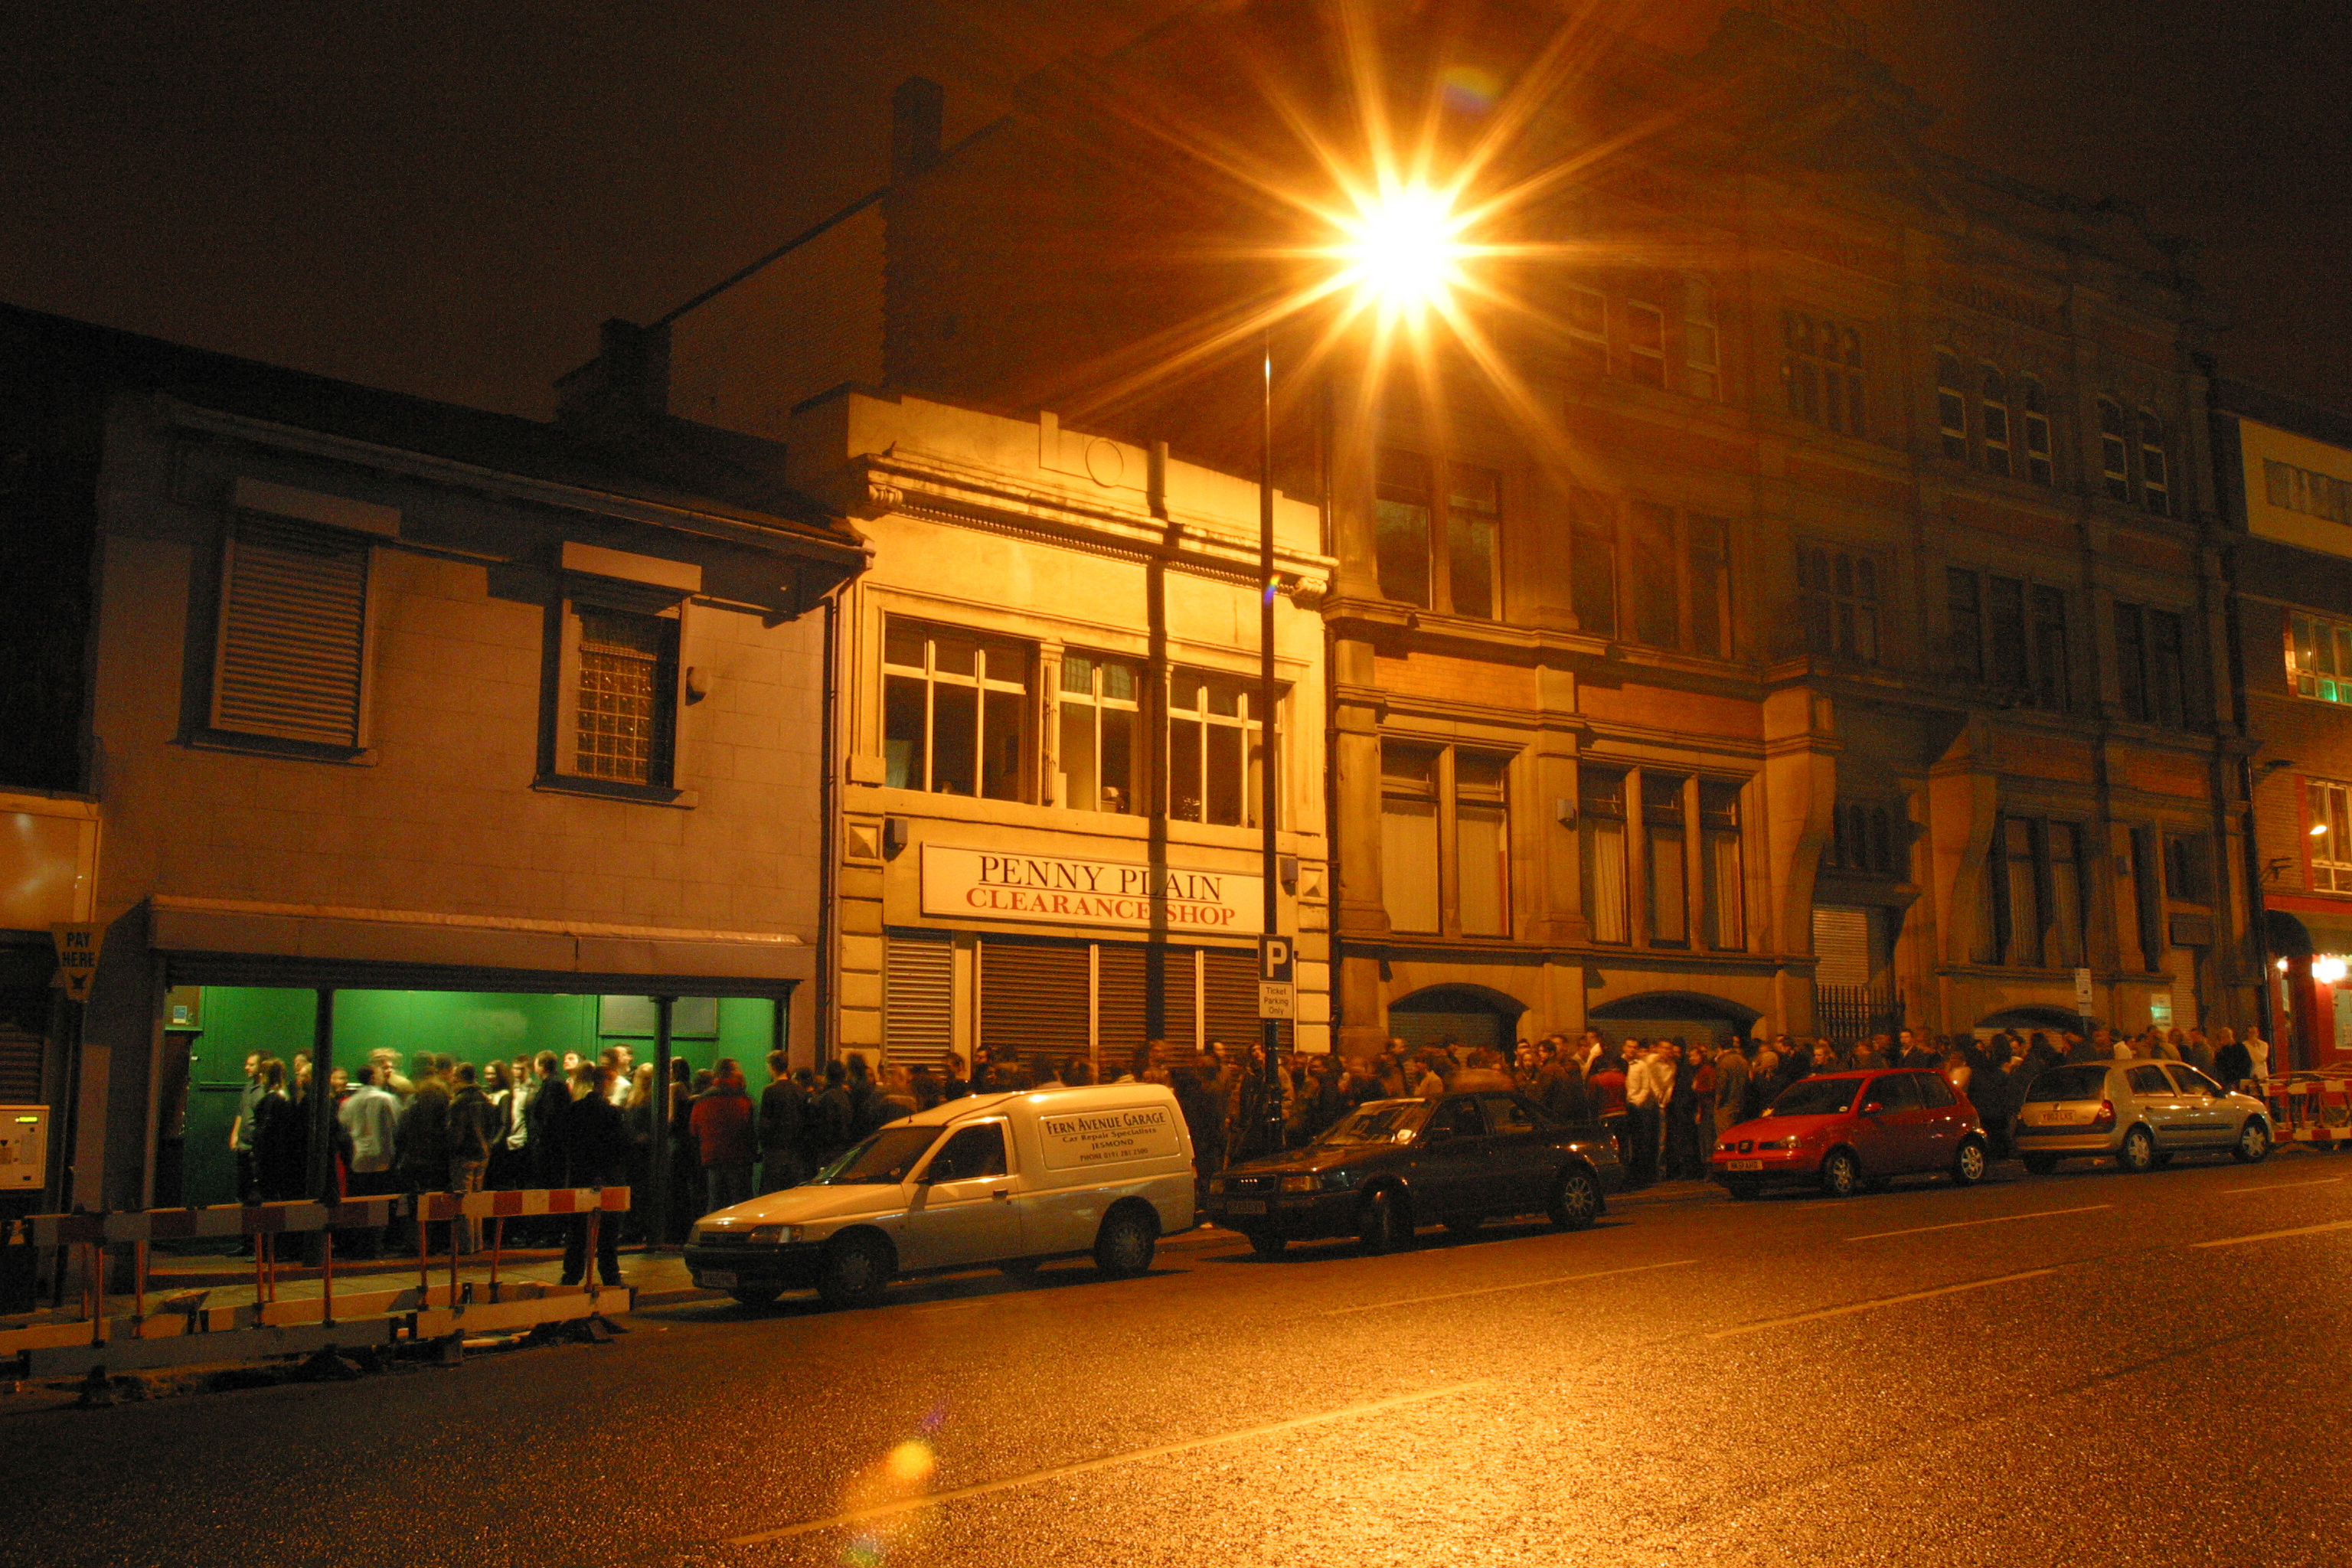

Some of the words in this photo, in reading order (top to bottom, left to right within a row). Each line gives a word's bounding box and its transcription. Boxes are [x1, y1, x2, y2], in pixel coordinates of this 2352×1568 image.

[978, 855, 1105, 893] PENNY
[1119, 868, 1223, 902] PLAIN
[966, 888, 1150, 921] CLEARANCE
[1165, 903, 1236, 926] SHOP
[67, 931, 90, 948] PAY
[62, 952, 95, 968] HERE
[1266, 940, 1287, 978] P
[1266, 986, 1286, 995] Ticket
[1263, 996, 1289, 1007] Parking
[1269, 1007, 1284, 1015] Only
[1046, 1121, 1076, 1135] FERN
[1078, 1116, 1122, 1132] AVENUE
[1123, 1112, 1166, 1126] GARAGE
[1081, 1133, 1108, 1142] Repair
[1112, 1128, 1157, 1138] Specialists
[1092, 1139, 1134, 1150] JESMOND
[1080, 1153, 1102, 1161] PHONE
